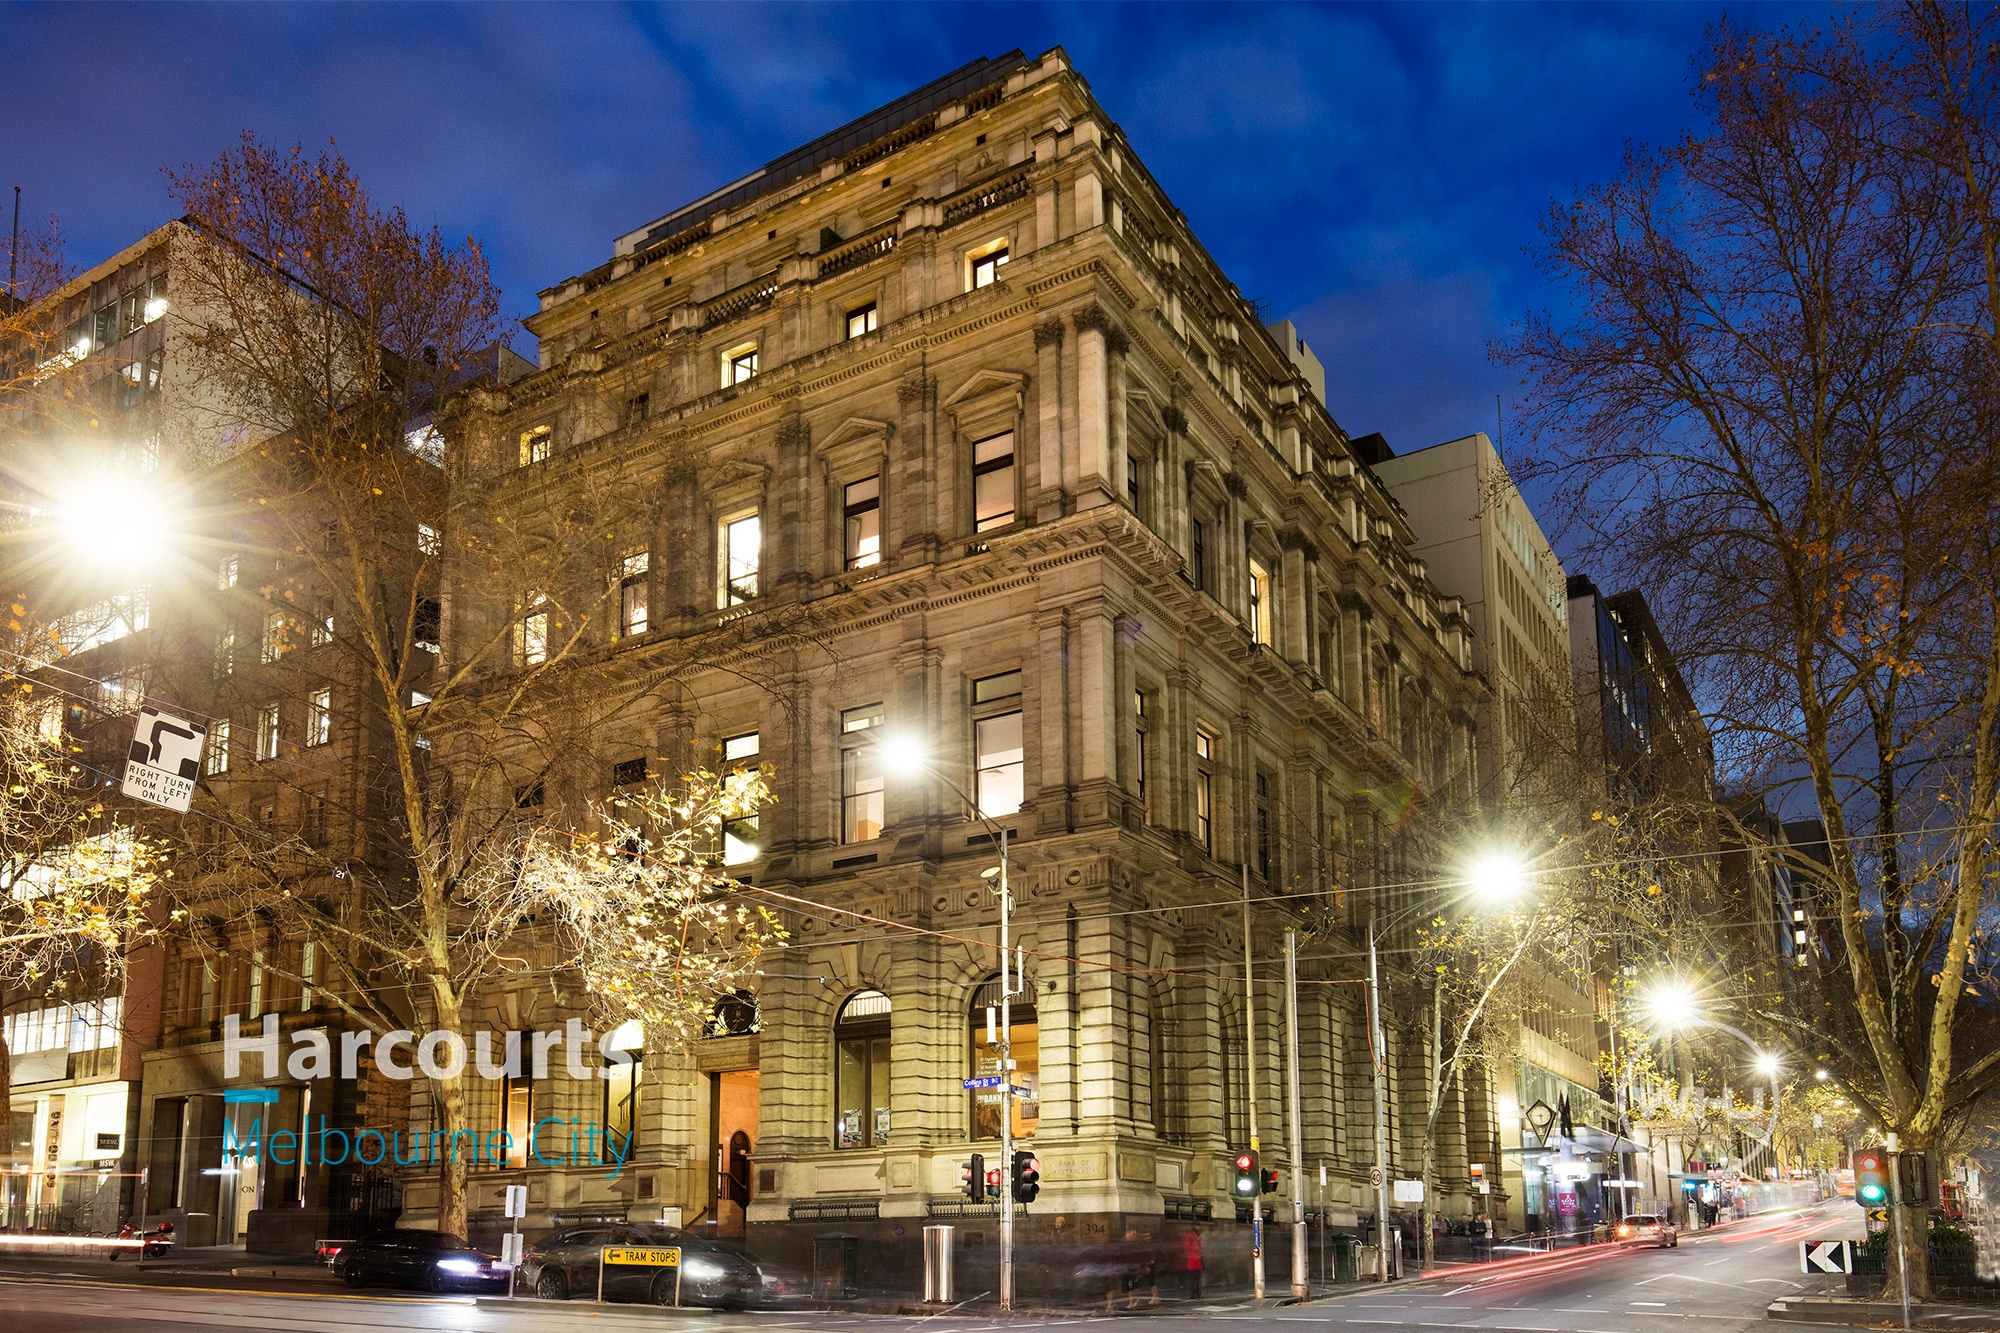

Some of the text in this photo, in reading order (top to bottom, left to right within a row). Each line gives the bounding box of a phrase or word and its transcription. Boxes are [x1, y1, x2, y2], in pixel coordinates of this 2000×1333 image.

[129, 765, 191, 791] RIGHT TURN
[128, 775, 187, 799] FROM LEFT
[142, 789, 170, 804] ONLY
[335, 870, 345, 880] 21
[1372, 1173, 1380, 1182] 40
[1085, 1223, 1105, 1235] 394
[625, 1251, 676, 1262] TRAM STOPS
